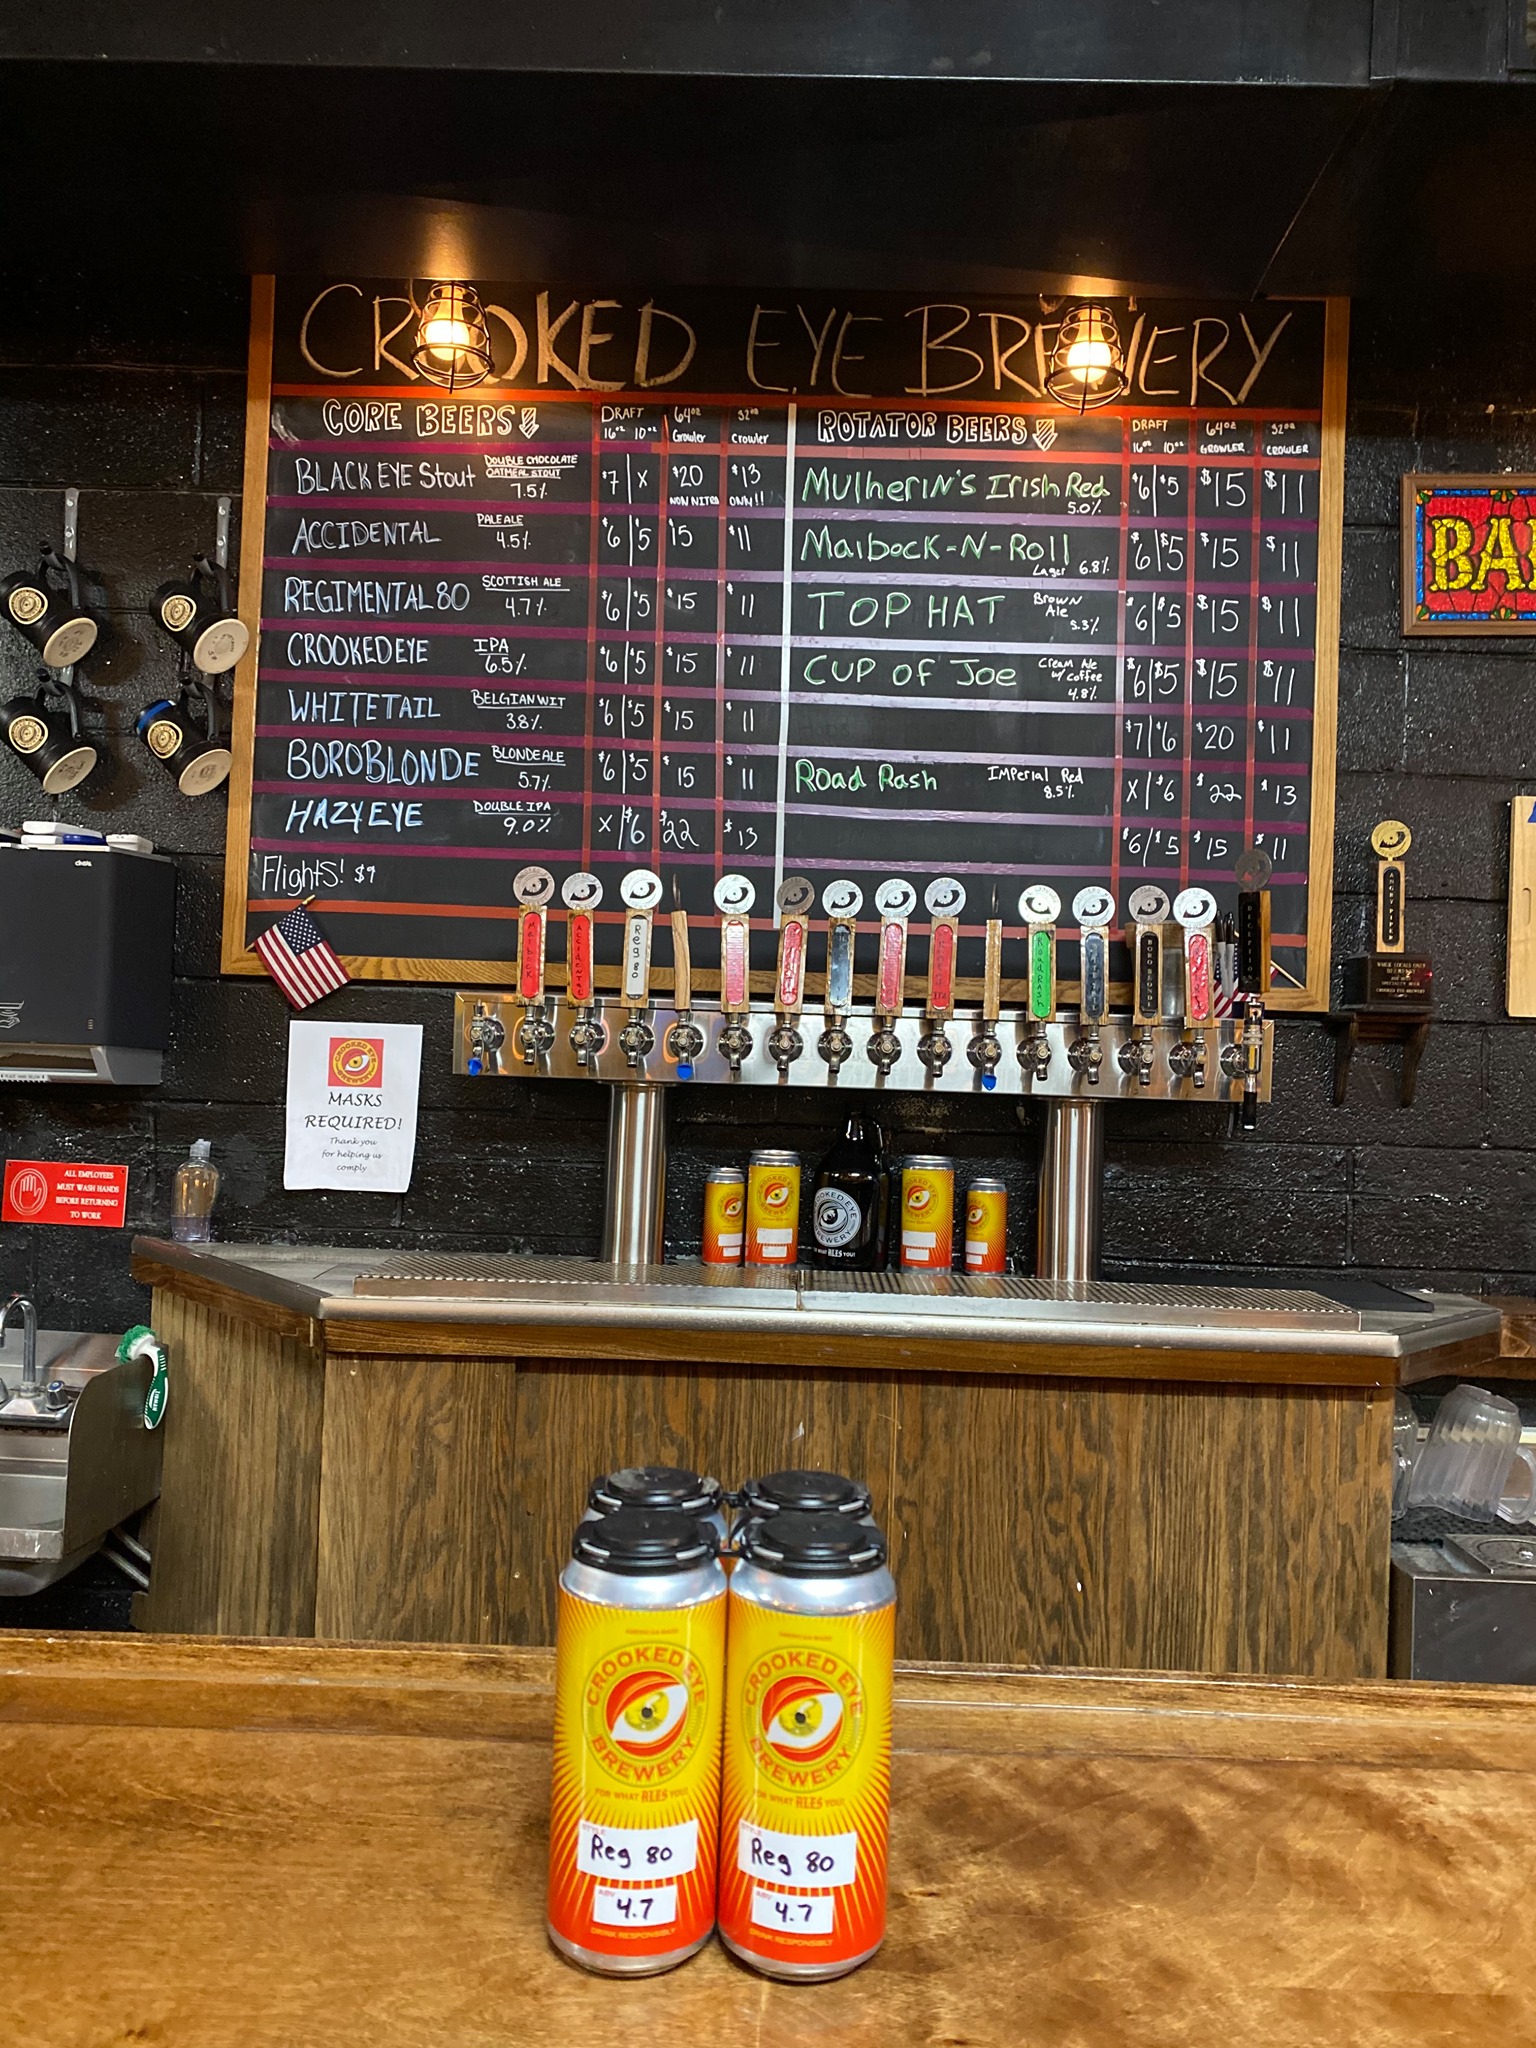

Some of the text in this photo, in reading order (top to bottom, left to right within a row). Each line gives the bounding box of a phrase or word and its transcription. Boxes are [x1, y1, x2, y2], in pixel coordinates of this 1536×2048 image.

[749, 303, 885, 398] EYE
[322, 398, 515, 438] CORE BEERS
[602, 405, 645, 423] DRAFT
[817, 409, 1028, 444] ROTATOR BEERS
[1132, 419, 1168, 432] DRAFT
[672, 429, 706, 443] Growler
[1200, 444, 1245, 455] GROWLER
[1266, 444, 1309, 456] CROWLER
[484, 455, 524, 467] DOUBLE
[295, 457, 476, 495] BLACK EYE Stout
[485, 468, 562, 479] OATMEAL STOUT
[1065, 471, 1111, 499] Red
[292, 517, 442, 555] ACCIDENTAL
[1429, 516, 1536, 592] BA
[1032, 563, 1066, 578] Lager
[481, 574, 562, 588] SCOTTISH ALE
[284, 576, 470, 614] REGIMENTAL 80
[808, 591, 1005, 630] TOP HAT
[1045, 605, 1069, 618] Ale
[287, 632, 429, 667] CROOKED EYE
[473, 638, 509, 653] IPA
[950, 658, 1017, 687] Joe
[795, 759, 938, 793] Road Rash
[1061, 767, 1083, 784] Red
[472, 800, 551, 813] DOUBLE IPA
[285, 798, 424, 834] HAZY EYE
[354, 864, 376, 884] $9
[328, 1091, 383, 1107] MASKS
[304, 1115, 402, 1131] REQUIRED!
[330, 1137, 377, 1148] Thank you
[321, 1150, 335, 1159] for
[336, 1150, 371, 1160] helping
[78, 1171, 114, 1179] EMPLOYEES
[336, 1164, 367, 1173] comply
[57, 1183, 119, 1193] MUST WASH HANDS
[55, 1196, 118, 1206] BEFORE RETURNING
[845, 1200, 858, 1219] EYE
[81, 1211, 101, 1219] WORK
[586, 1646, 706, 1707] CROOKED EYE
[745, 1651, 864, 1717] CROOKED EYE
[591, 1734, 694, 1782] BREWERY
[750, 1735, 851, 1787] BREWERY
[613, 1790, 639, 1801] WHAT
[591, 1833, 673, 1869] Reg 80
[751, 1837, 835, 1877] Reg 80
[616, 1897, 654, 1920] 4.7
[775, 1901, 813, 1923] 4.7
